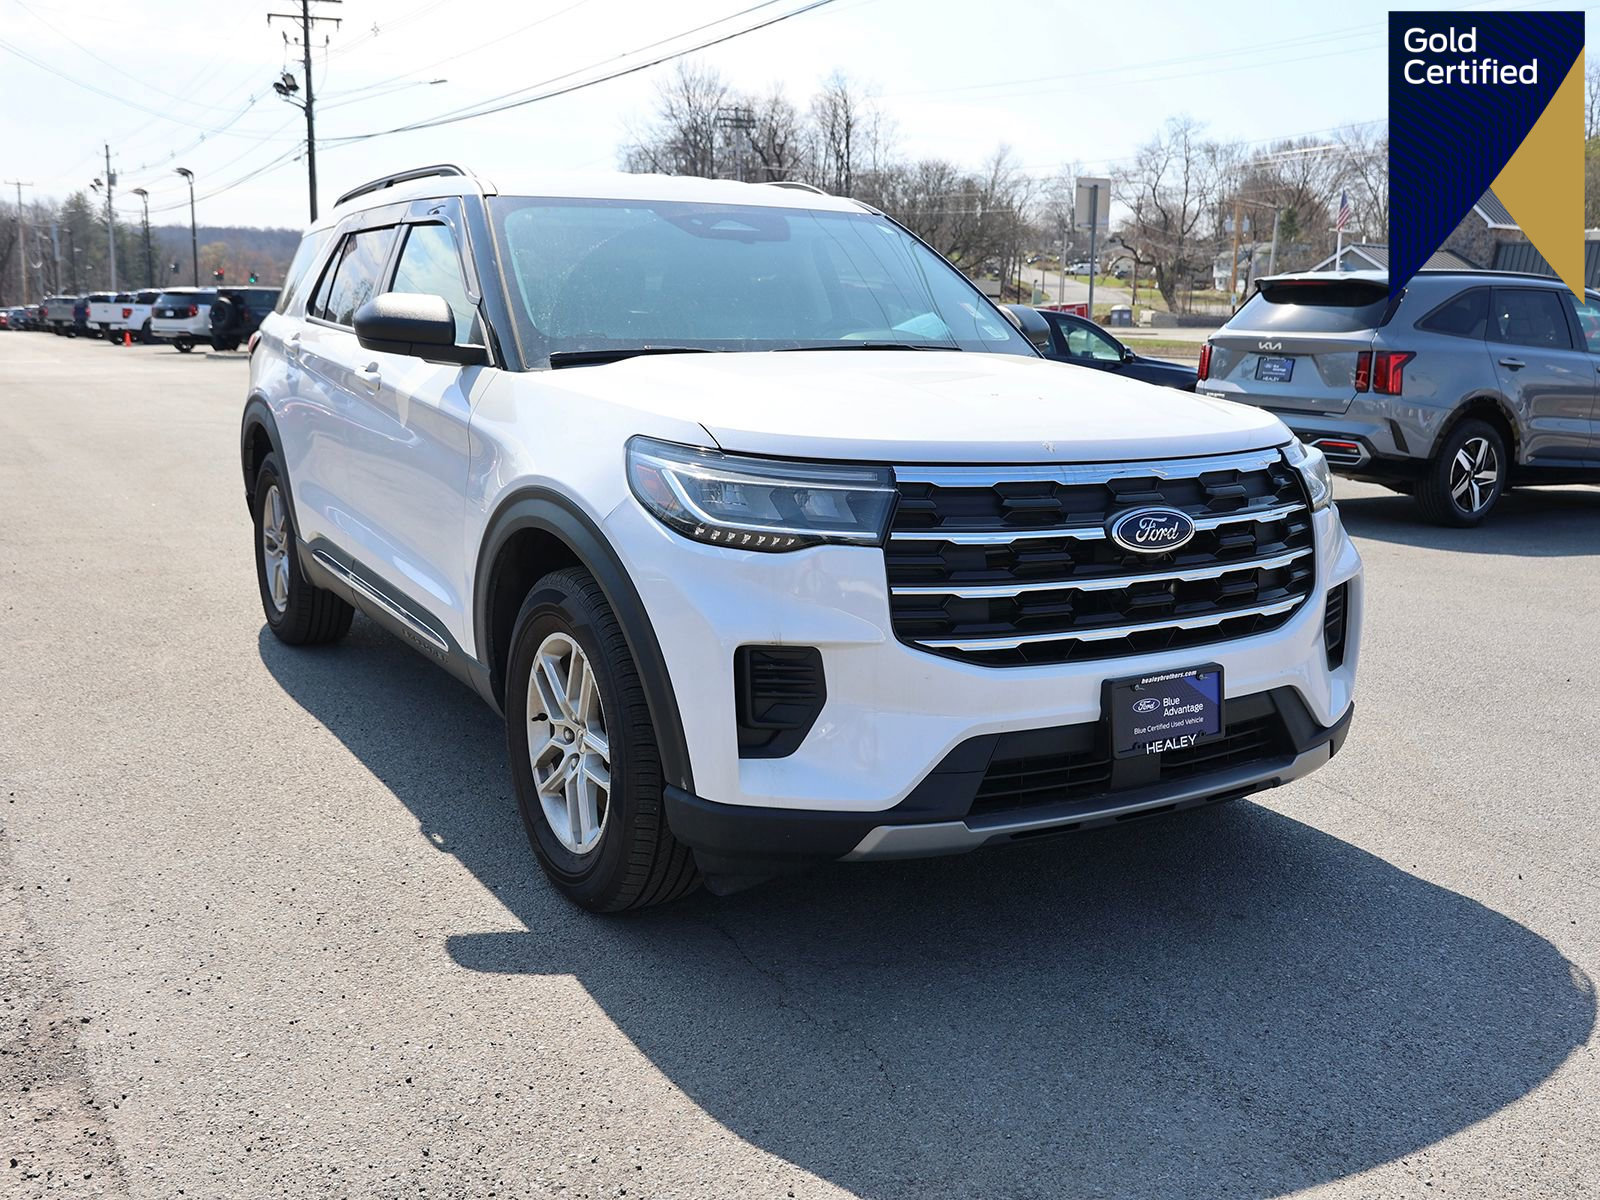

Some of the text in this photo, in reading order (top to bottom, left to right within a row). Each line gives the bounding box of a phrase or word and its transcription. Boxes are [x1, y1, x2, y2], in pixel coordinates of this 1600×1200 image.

[1135, 517, 1180, 543] Ford
[1141, 670, 1197, 685] healeybrothers.com
[1137, 700, 1156, 711] Ford
[1162, 697, 1180, 707] Blue
[1163, 702, 1204, 717] Advantage
[1133, 716, 1204, 735] Blue Certified Used Vehicle
[1146, 733, 1197, 755] HEALEY
